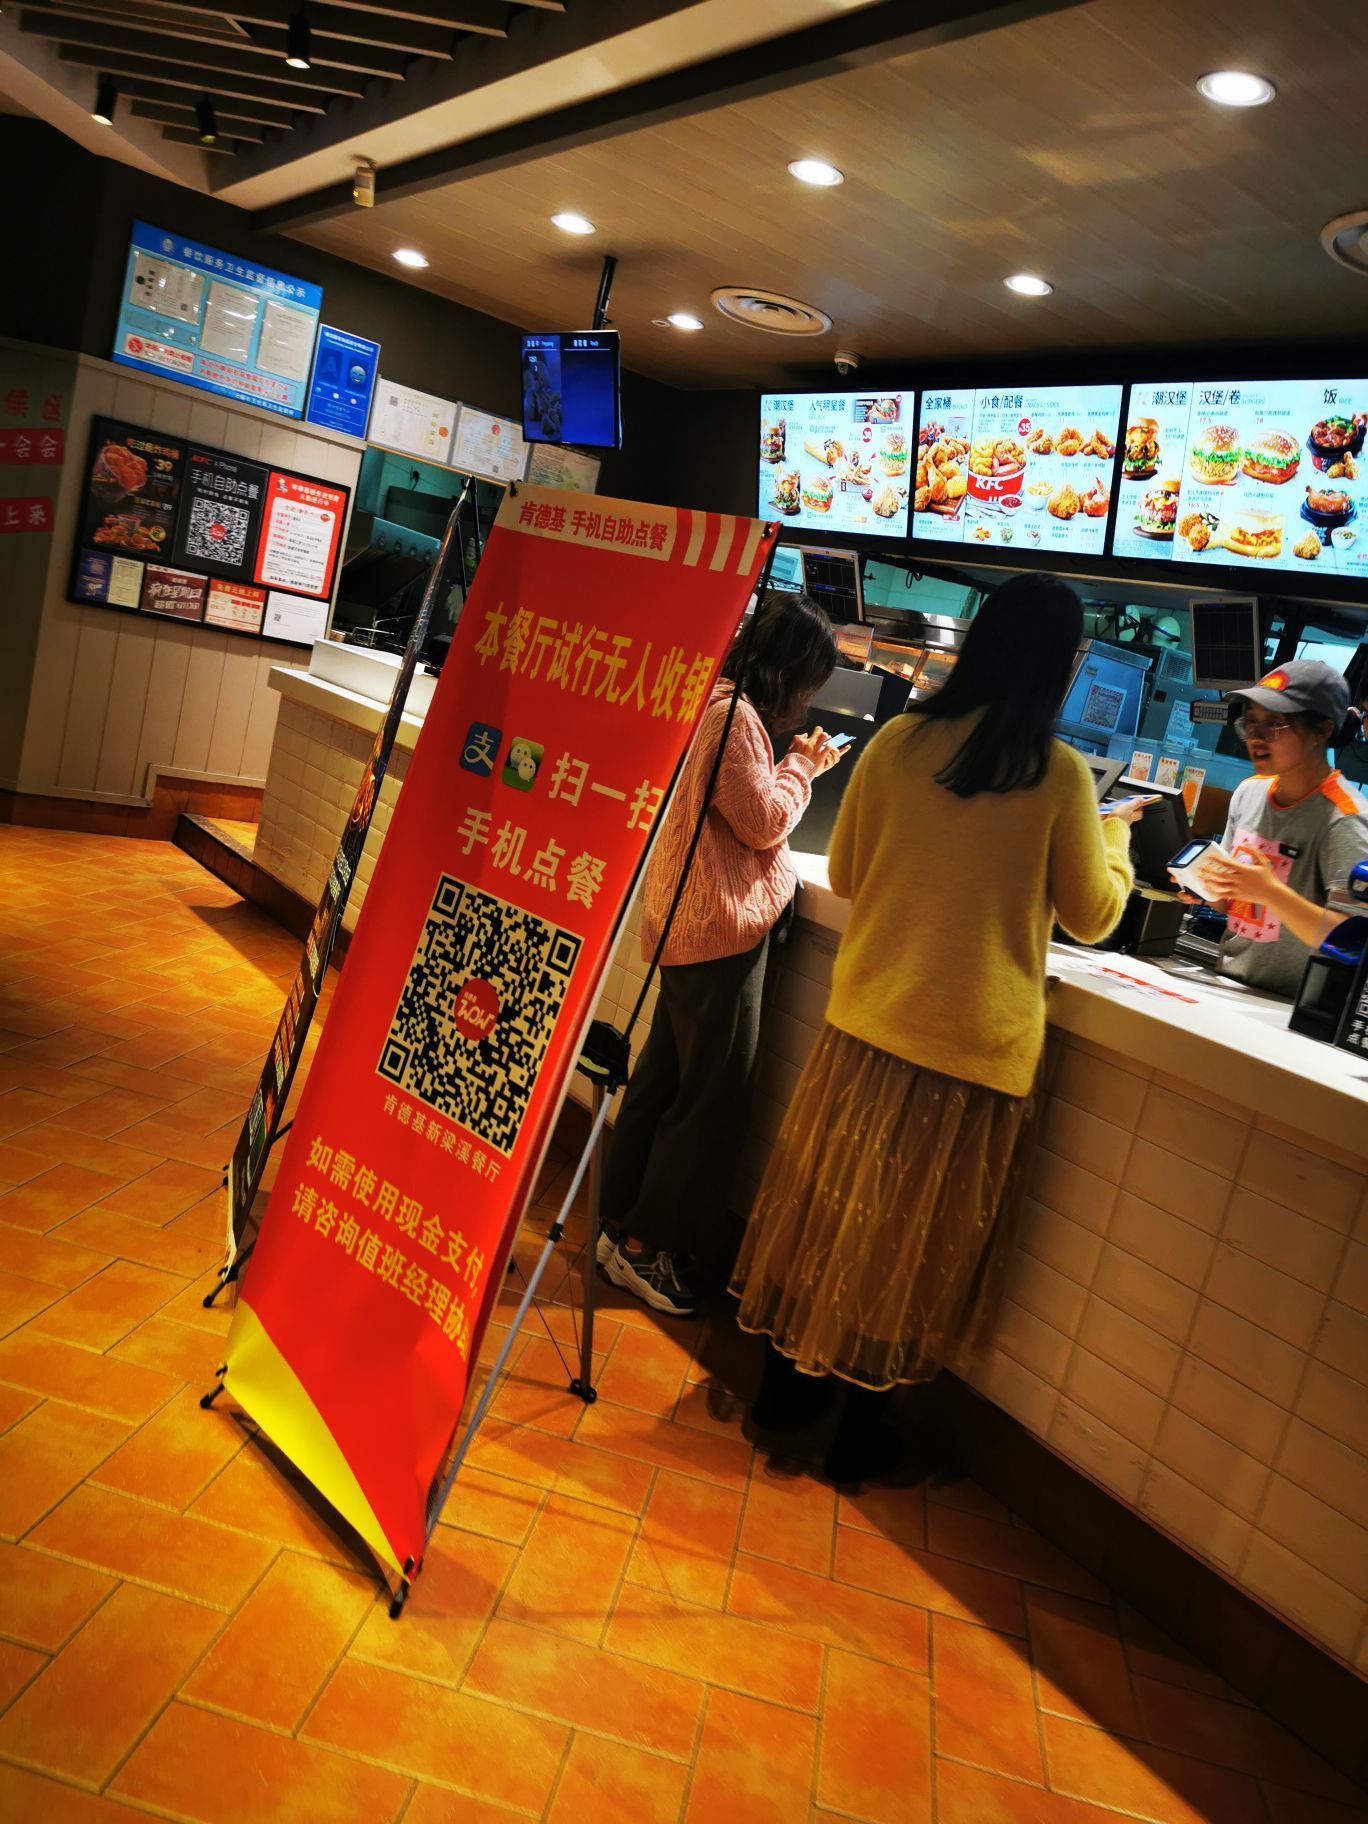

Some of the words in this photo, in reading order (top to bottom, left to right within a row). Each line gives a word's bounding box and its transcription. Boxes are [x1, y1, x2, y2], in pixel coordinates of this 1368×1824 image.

[773, 398, 795, 412] 潮汉堡
[809, 398, 846, 412] 人气明星餐
[924, 396, 952, 411] 全家桶
[980, 393, 1023, 410] 小食/配餐
[1151, 390, 1187, 406] 潮汉堡
[1199, 389, 1241, 406] 汉堡/卷
[1323, 388, 1337, 405] 饭
[190, 468, 260, 501] 手机自助点餐
[974, 476, 1004, 492] KFC
[518, 501, 567, 531] 肯德基
[570, 510, 669, 552] 手机自助点餐
[474, 601, 715, 725] 本餐厅试行无人收银
[548, 751, 665, 834] 扫一扫
[457, 807, 608, 910] 手机点餐
[383, 1092, 502, 1184] 肯德基新梁溪餐厅
